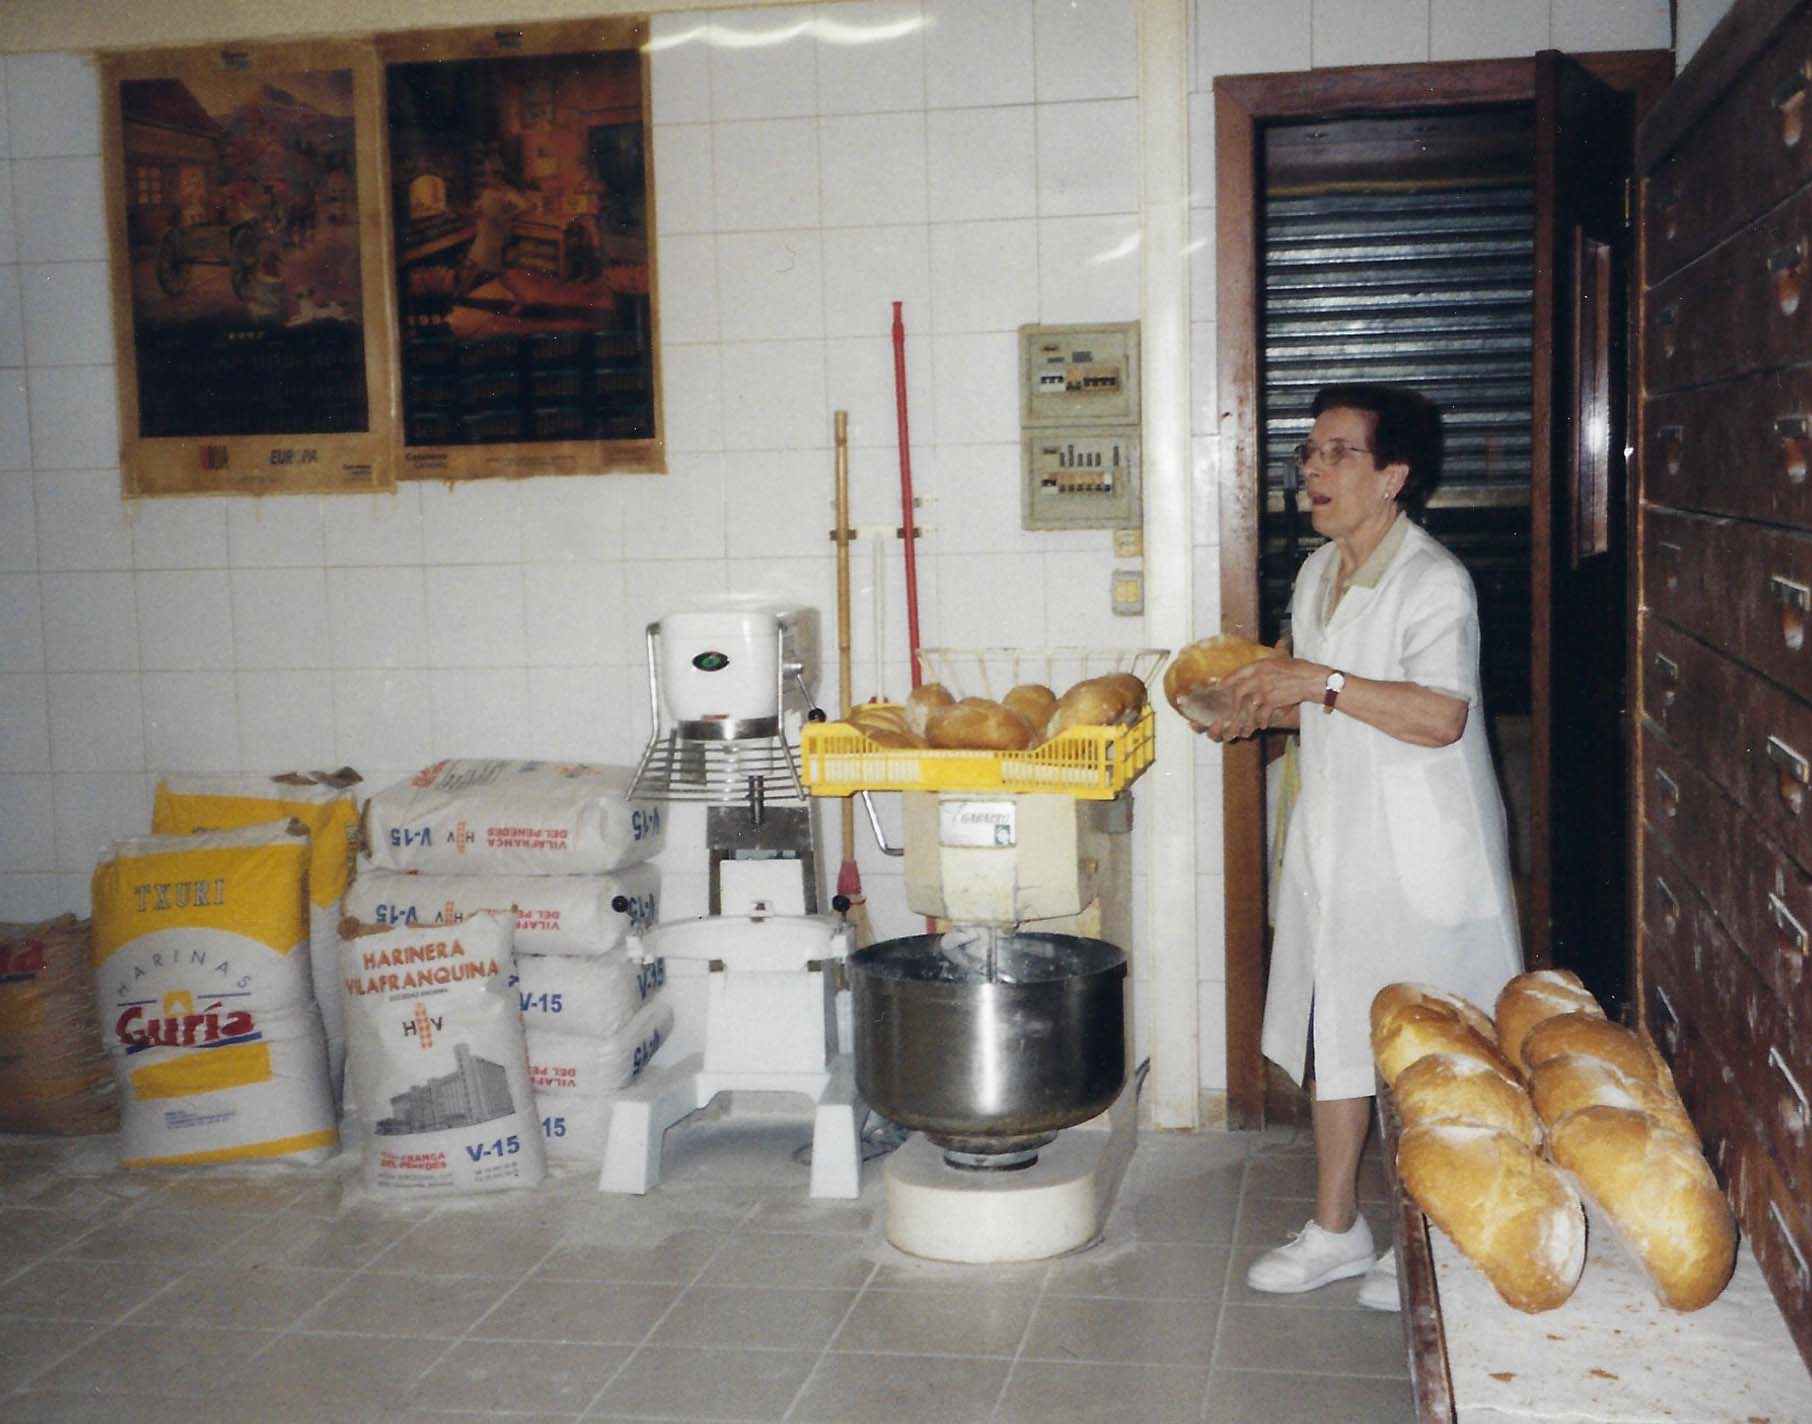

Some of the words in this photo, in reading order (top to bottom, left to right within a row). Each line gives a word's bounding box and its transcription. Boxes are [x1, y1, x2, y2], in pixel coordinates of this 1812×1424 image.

[487, 826, 536, 838] PENEDES
[540, 827, 569, 838] DEL
[631, 811, 660, 841] V-15
[389, 827, 433, 848] V-15
[487, 838, 568, 850] VILAFRANCA
[134, 878, 226, 913] TXURI
[375, 903, 418, 926] V-15
[537, 910, 560, 920] DEL
[362, 939, 466, 971] HARINERA
[117, 948, 252, 998] HARINAS
[345, 957, 501, 997] VILAFRANQUINA
[519, 992, 563, 1013] V-15
[115, 1001, 256, 1048] Guría
[552, 1066, 576, 1077] DEL
[541, 1117, 567, 1137] 15
[464, 1135, 521, 1163] V-15
